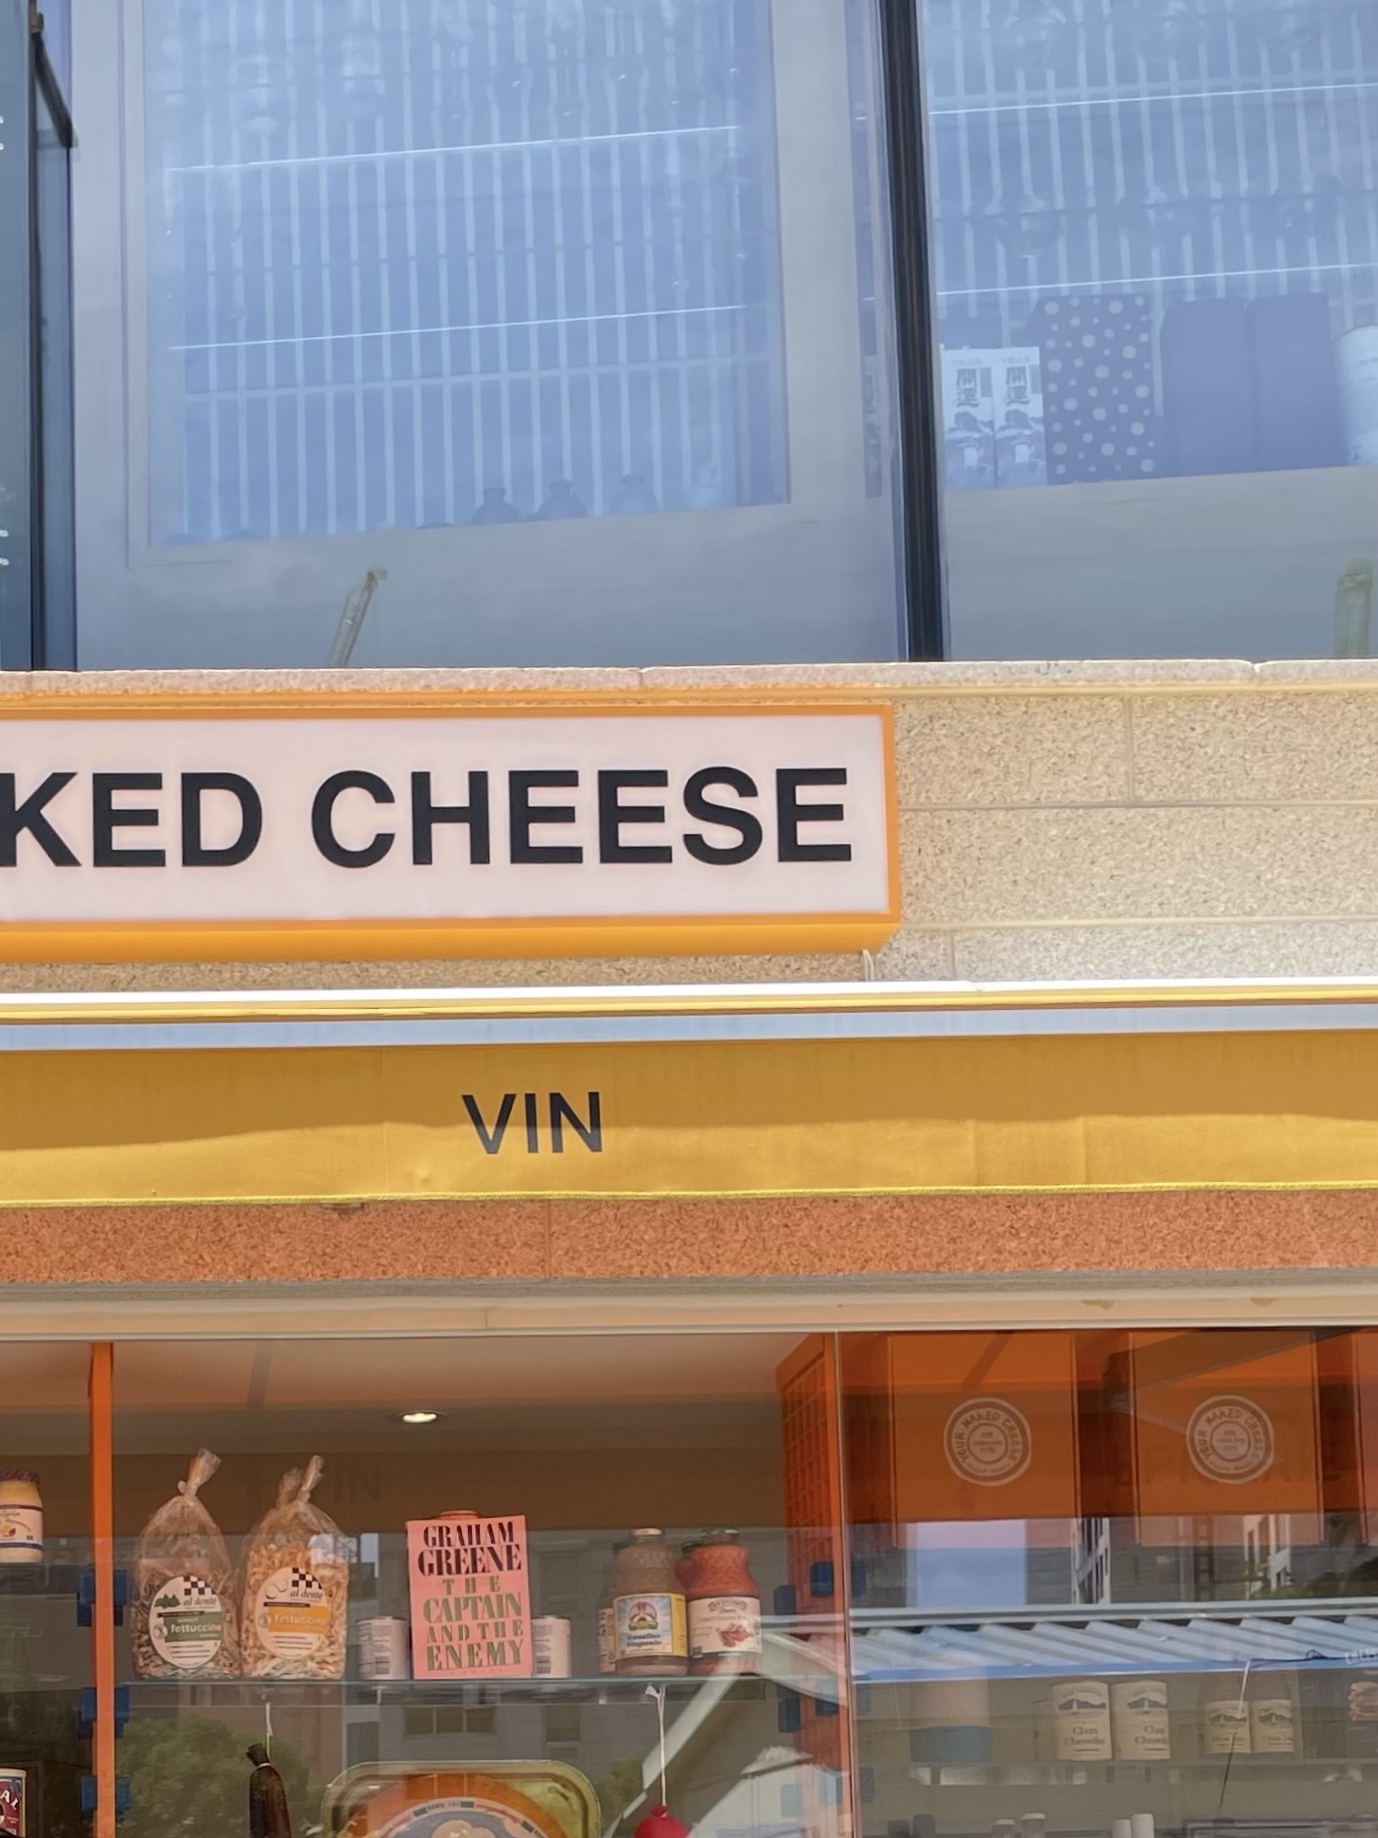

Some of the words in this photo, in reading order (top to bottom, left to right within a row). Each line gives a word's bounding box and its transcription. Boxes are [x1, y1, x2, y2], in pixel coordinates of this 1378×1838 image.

[311, 766, 852, 869] CHEESE
[461, 1091, 602, 1155] VIN
[423, 1521, 515, 1548] GRAHAM
[418, 1543, 523, 1577] GREENE
[443, 1575, 502, 1596] THE
[423, 1592, 523, 1625] CAPTAIN
[171, 1622, 222, 1634] fettuccine
[426, 1625, 470, 1644] AND
[477, 1620, 525, 1640] THE
[426, 1639, 525, 1672] ENEMY
[1072, 1726, 1099, 1736] Clam
